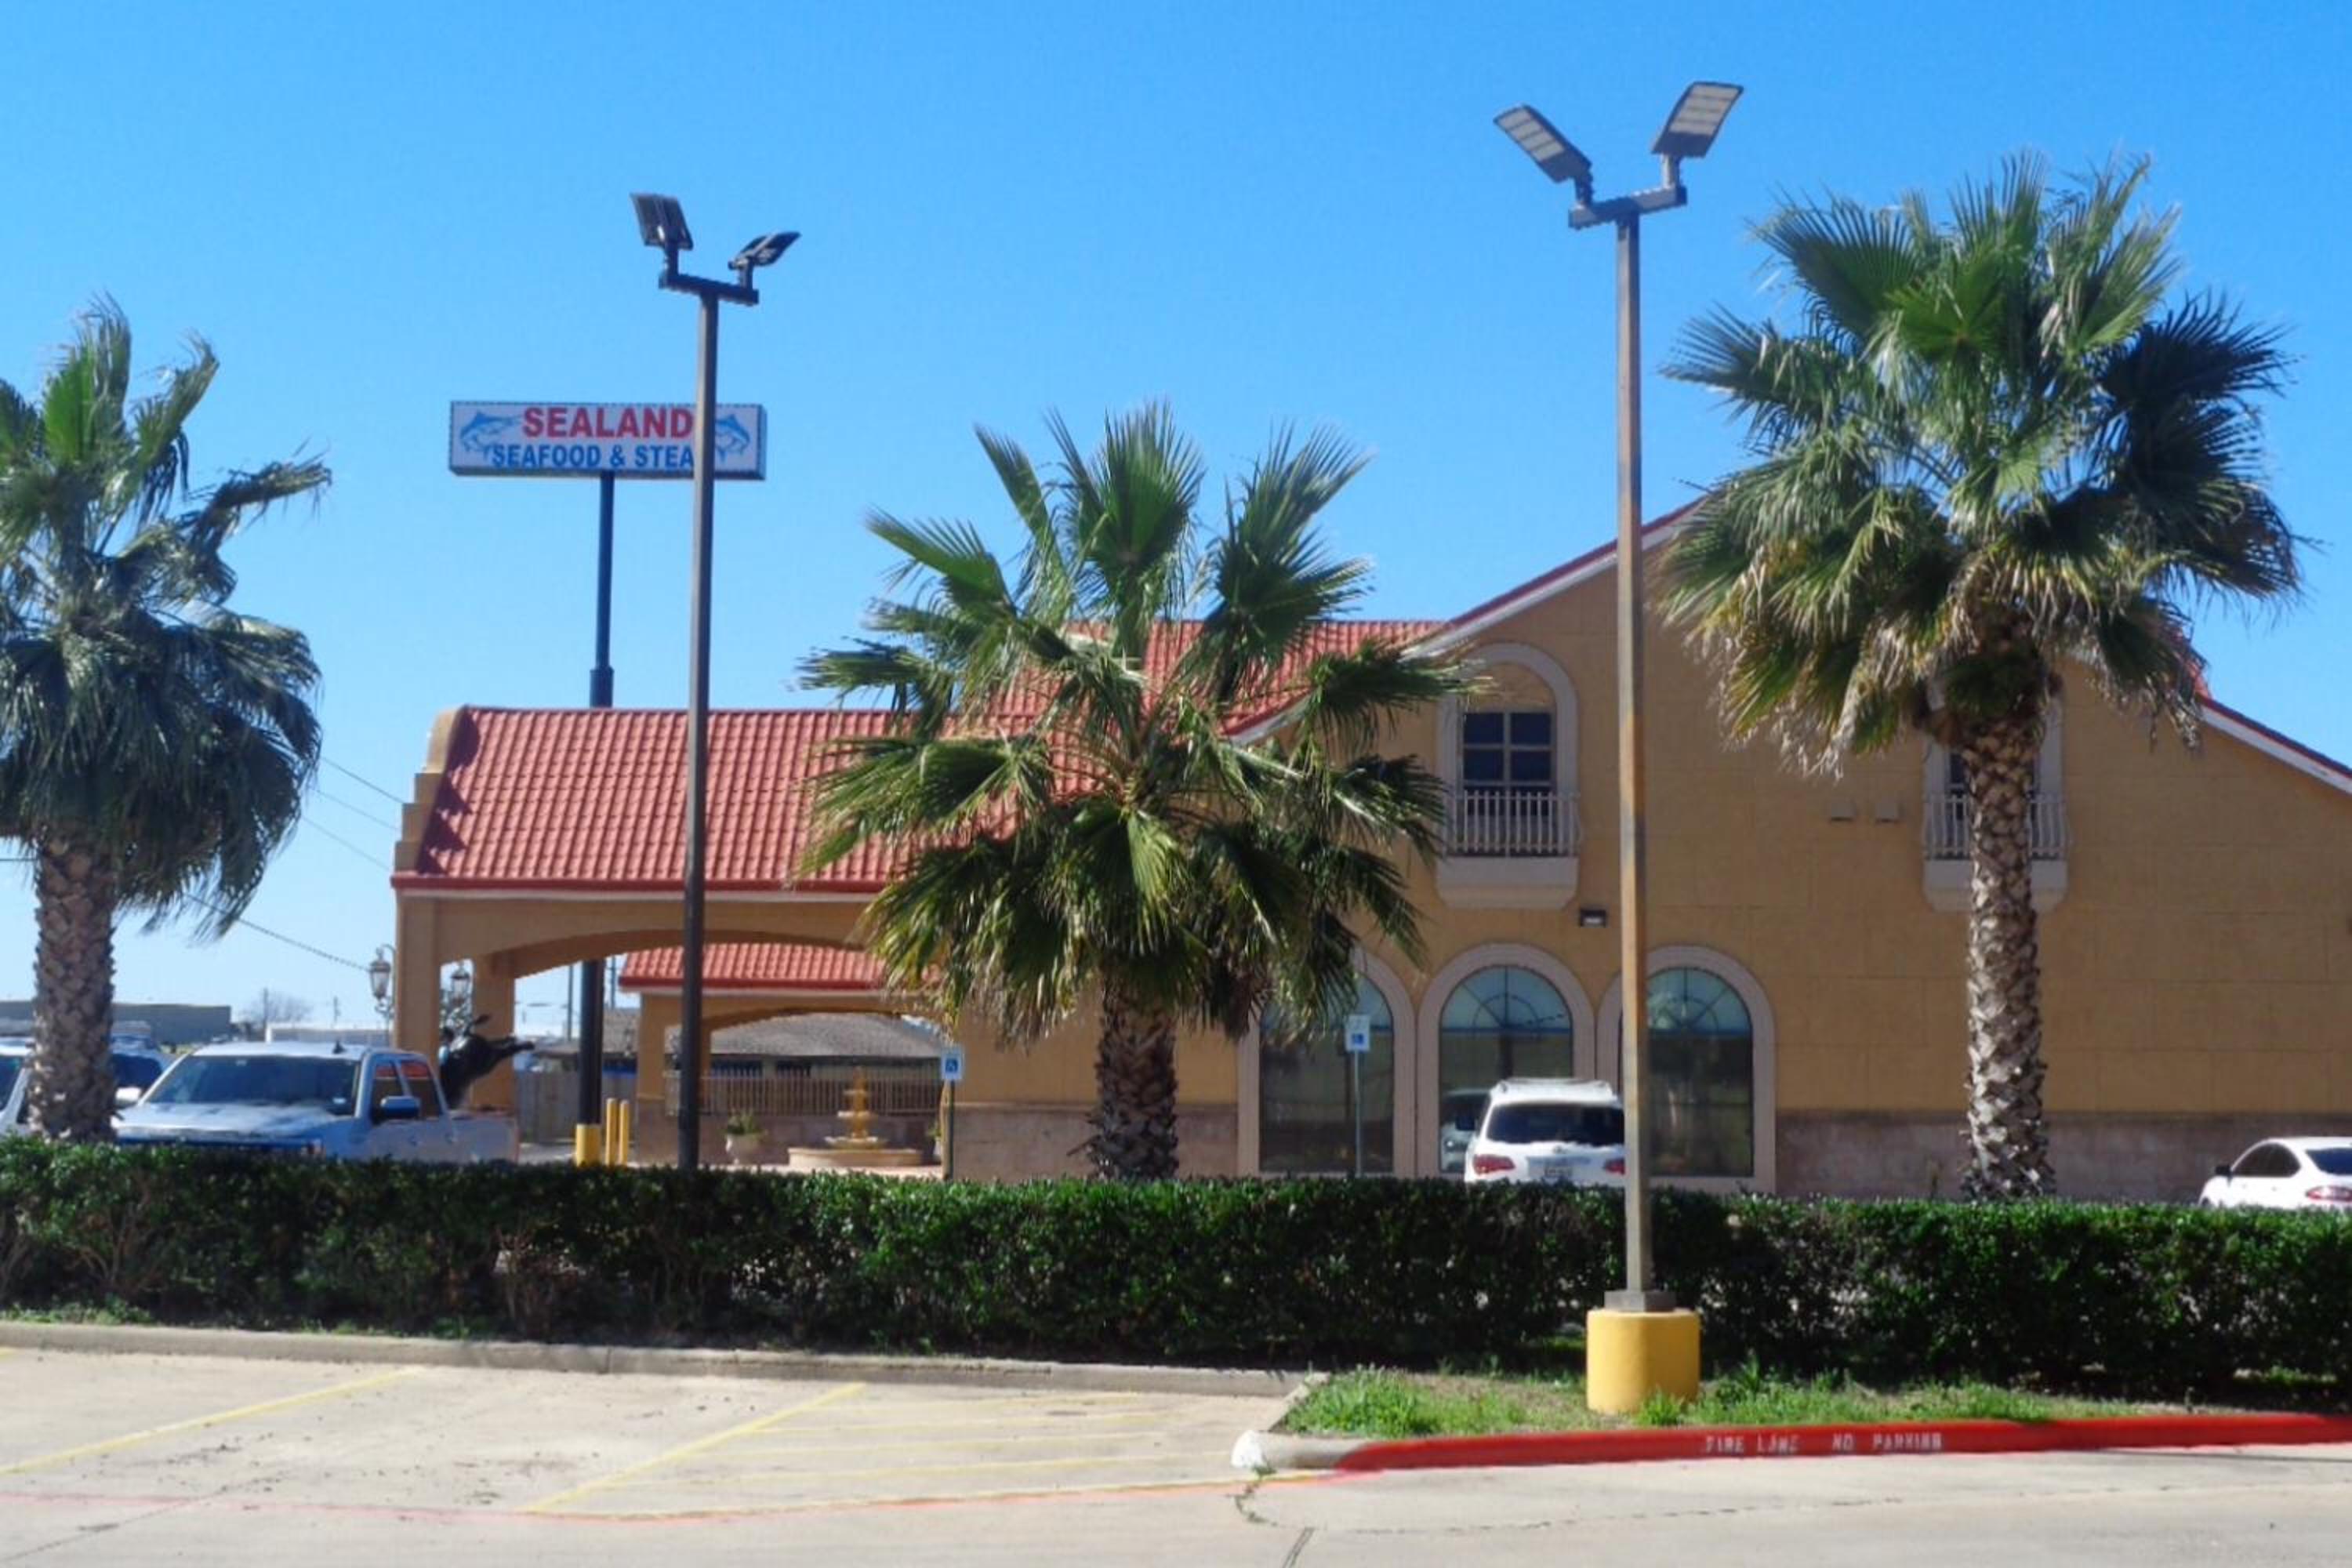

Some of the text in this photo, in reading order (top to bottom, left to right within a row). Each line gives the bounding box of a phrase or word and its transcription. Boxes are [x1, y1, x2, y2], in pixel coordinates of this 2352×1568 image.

[522, 407, 694, 438] SEALAND
[492, 444, 695, 468] SEAFOOD & STEA
[1705, 1432, 1943, 1454] FIRE LANE NO PARKING
